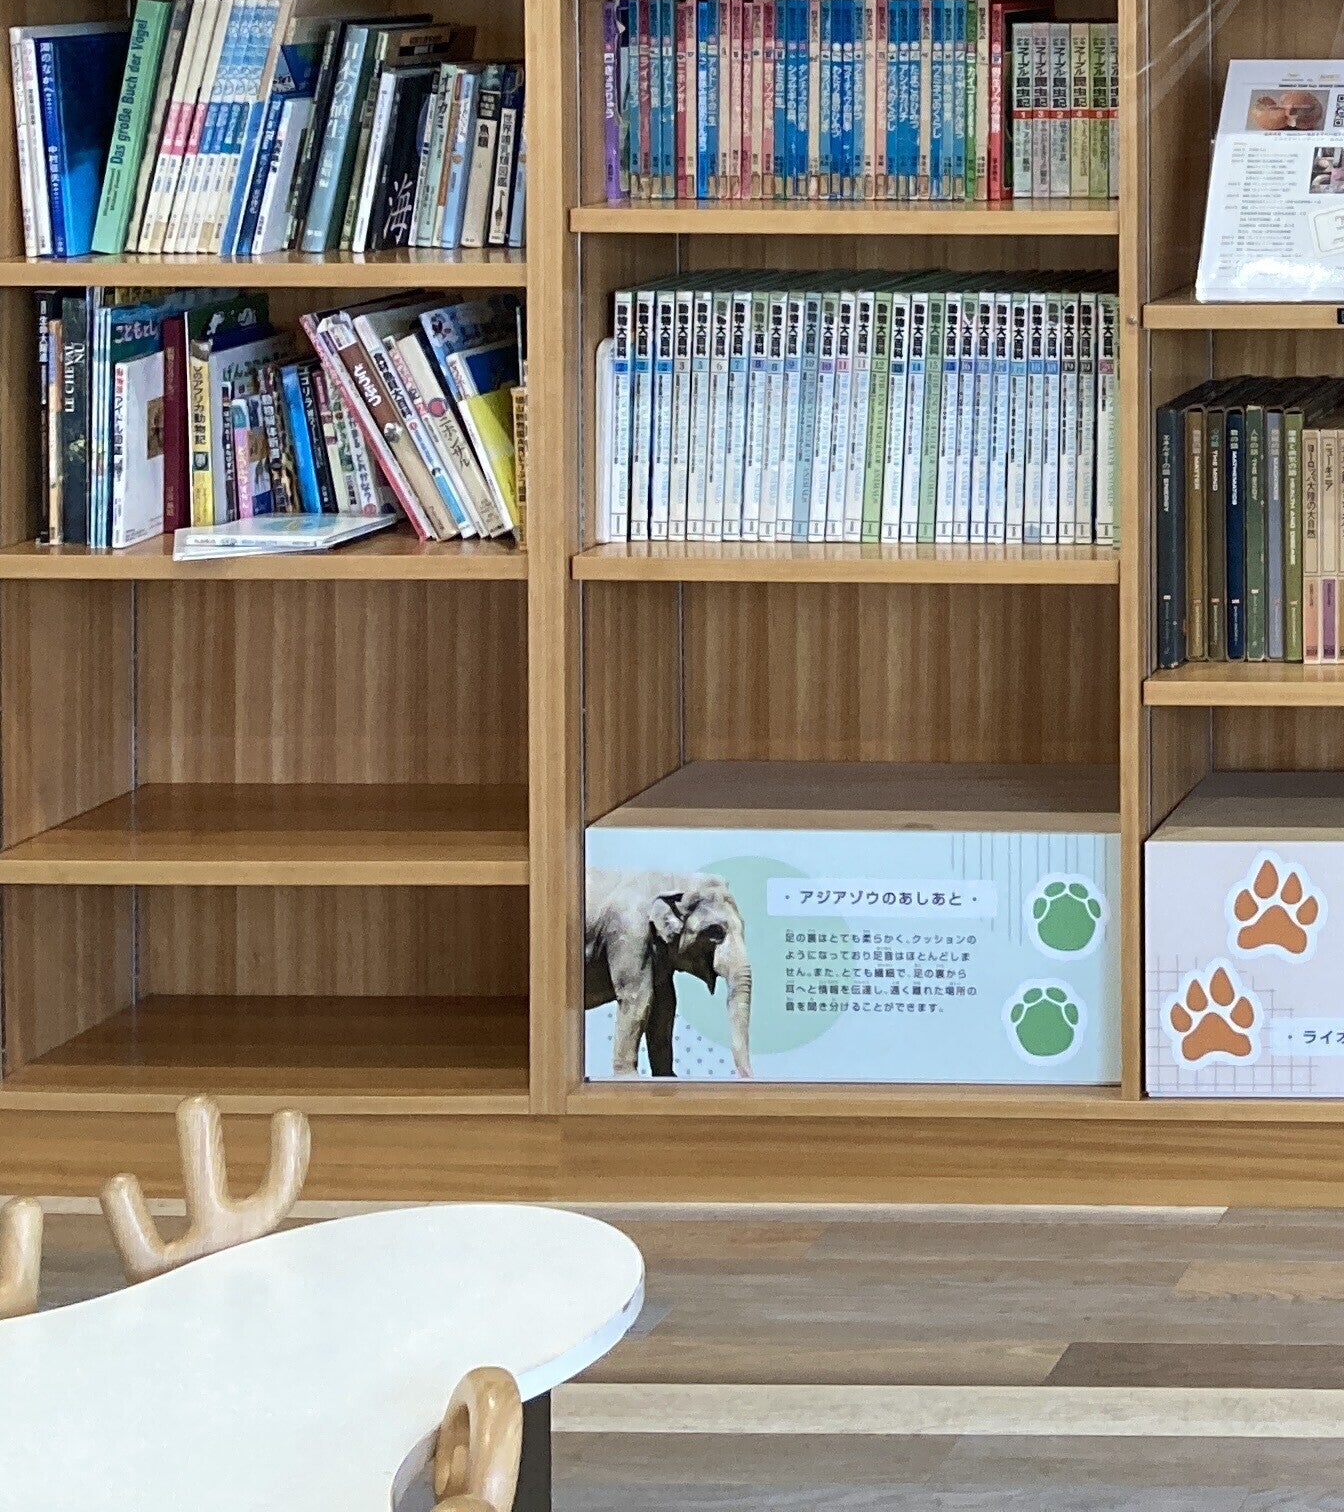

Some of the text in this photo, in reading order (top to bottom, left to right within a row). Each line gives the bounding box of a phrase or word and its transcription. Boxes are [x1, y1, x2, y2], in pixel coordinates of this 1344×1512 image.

[110, 18, 149, 165] Das große Buch der Vögel
[438, 416, 470, 467] ニホンザル
[800, 889, 963, 907] アジアゾウのあしあと
[785, 951, 970, 961] ようになっており足音はほとんどしま
